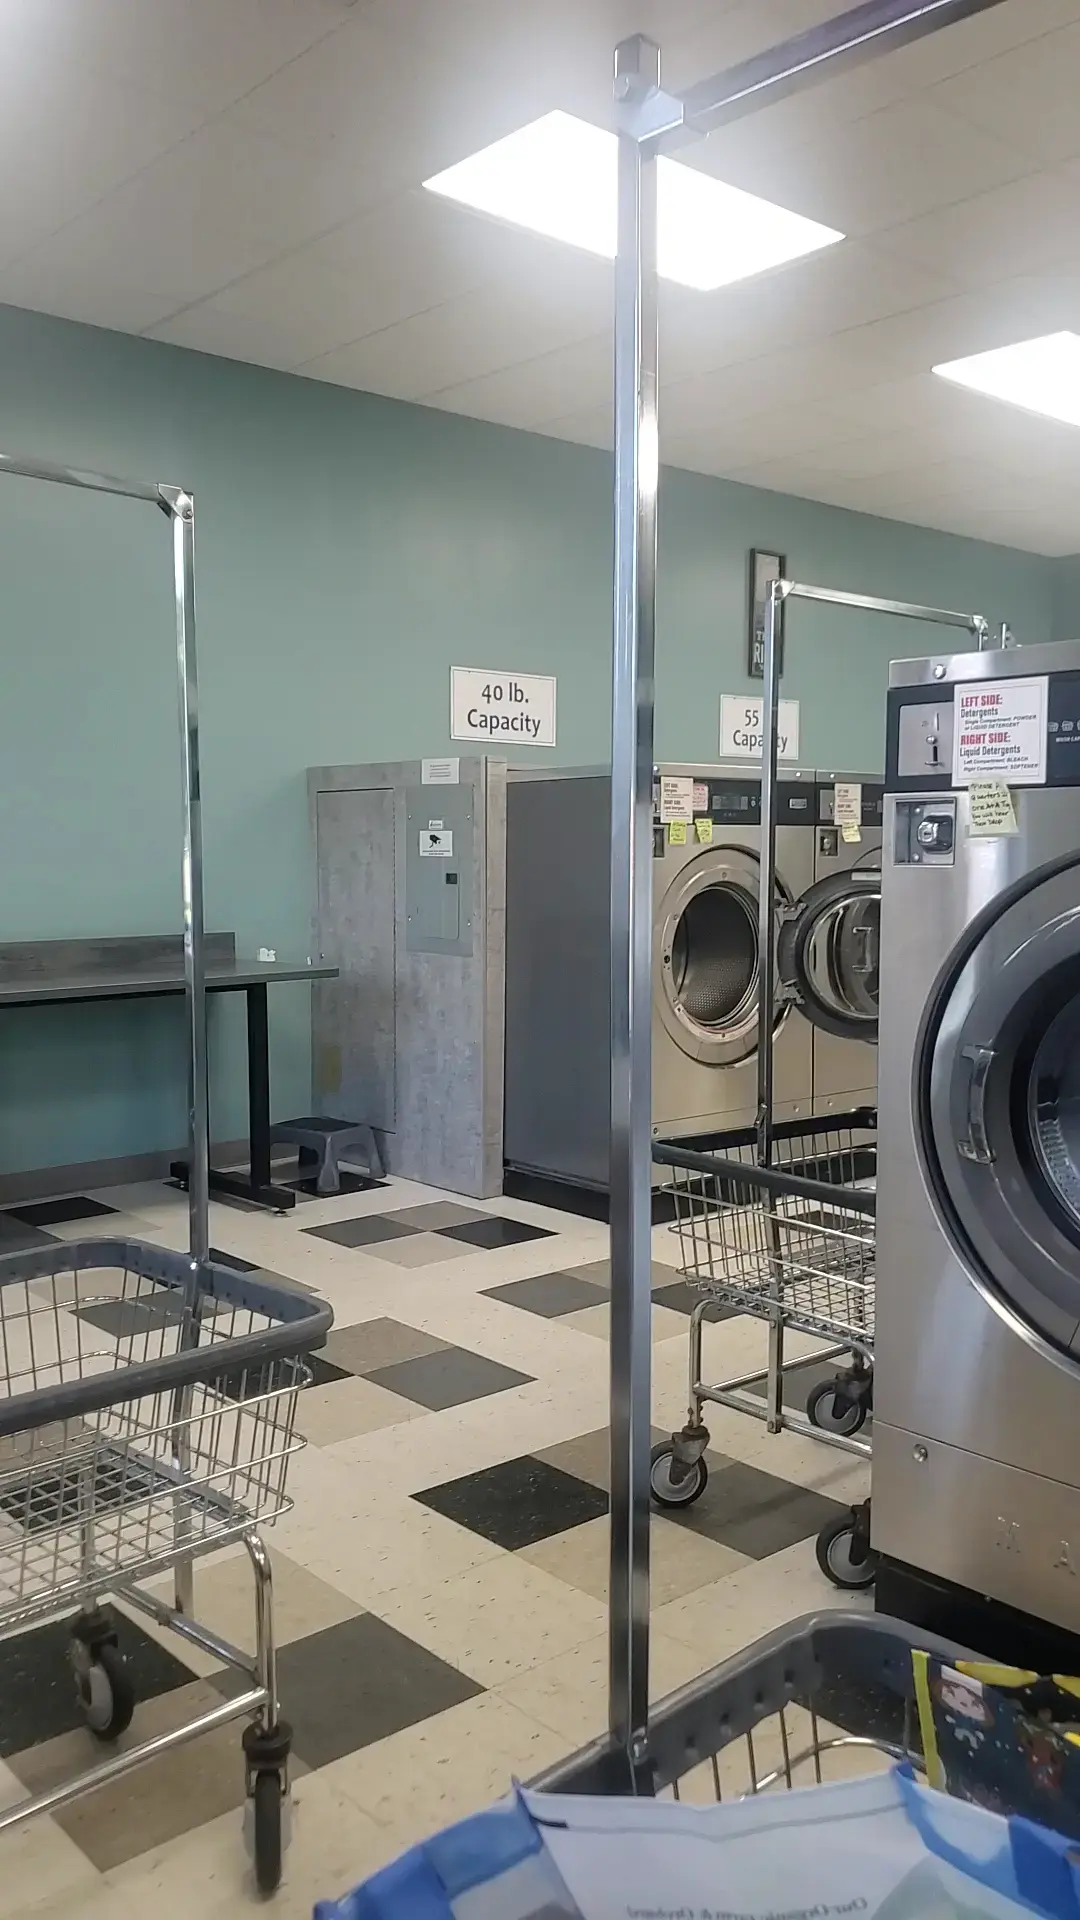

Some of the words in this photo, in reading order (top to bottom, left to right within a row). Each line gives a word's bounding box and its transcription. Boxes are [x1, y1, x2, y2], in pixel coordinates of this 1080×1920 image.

[481, 684, 504, 705] 40
[508, 681, 529, 704] lb.
[961, 696, 980, 708] LEFT
[981, 694, 1003, 706] SIDE:
[744, 709, 760, 728] 55
[960, 707, 999, 719] Detergents
[467, 708, 541, 738] Capacity
[988, 721, 1020, 729] DETERGENT
[733, 729, 788, 754] Capaty
[960, 733, 988, 746] RIGHT
[988, 731, 1011, 744] SIDE:
[960, 747, 981, 759] Liquid
[982, 744, 1021, 757] Detergents
